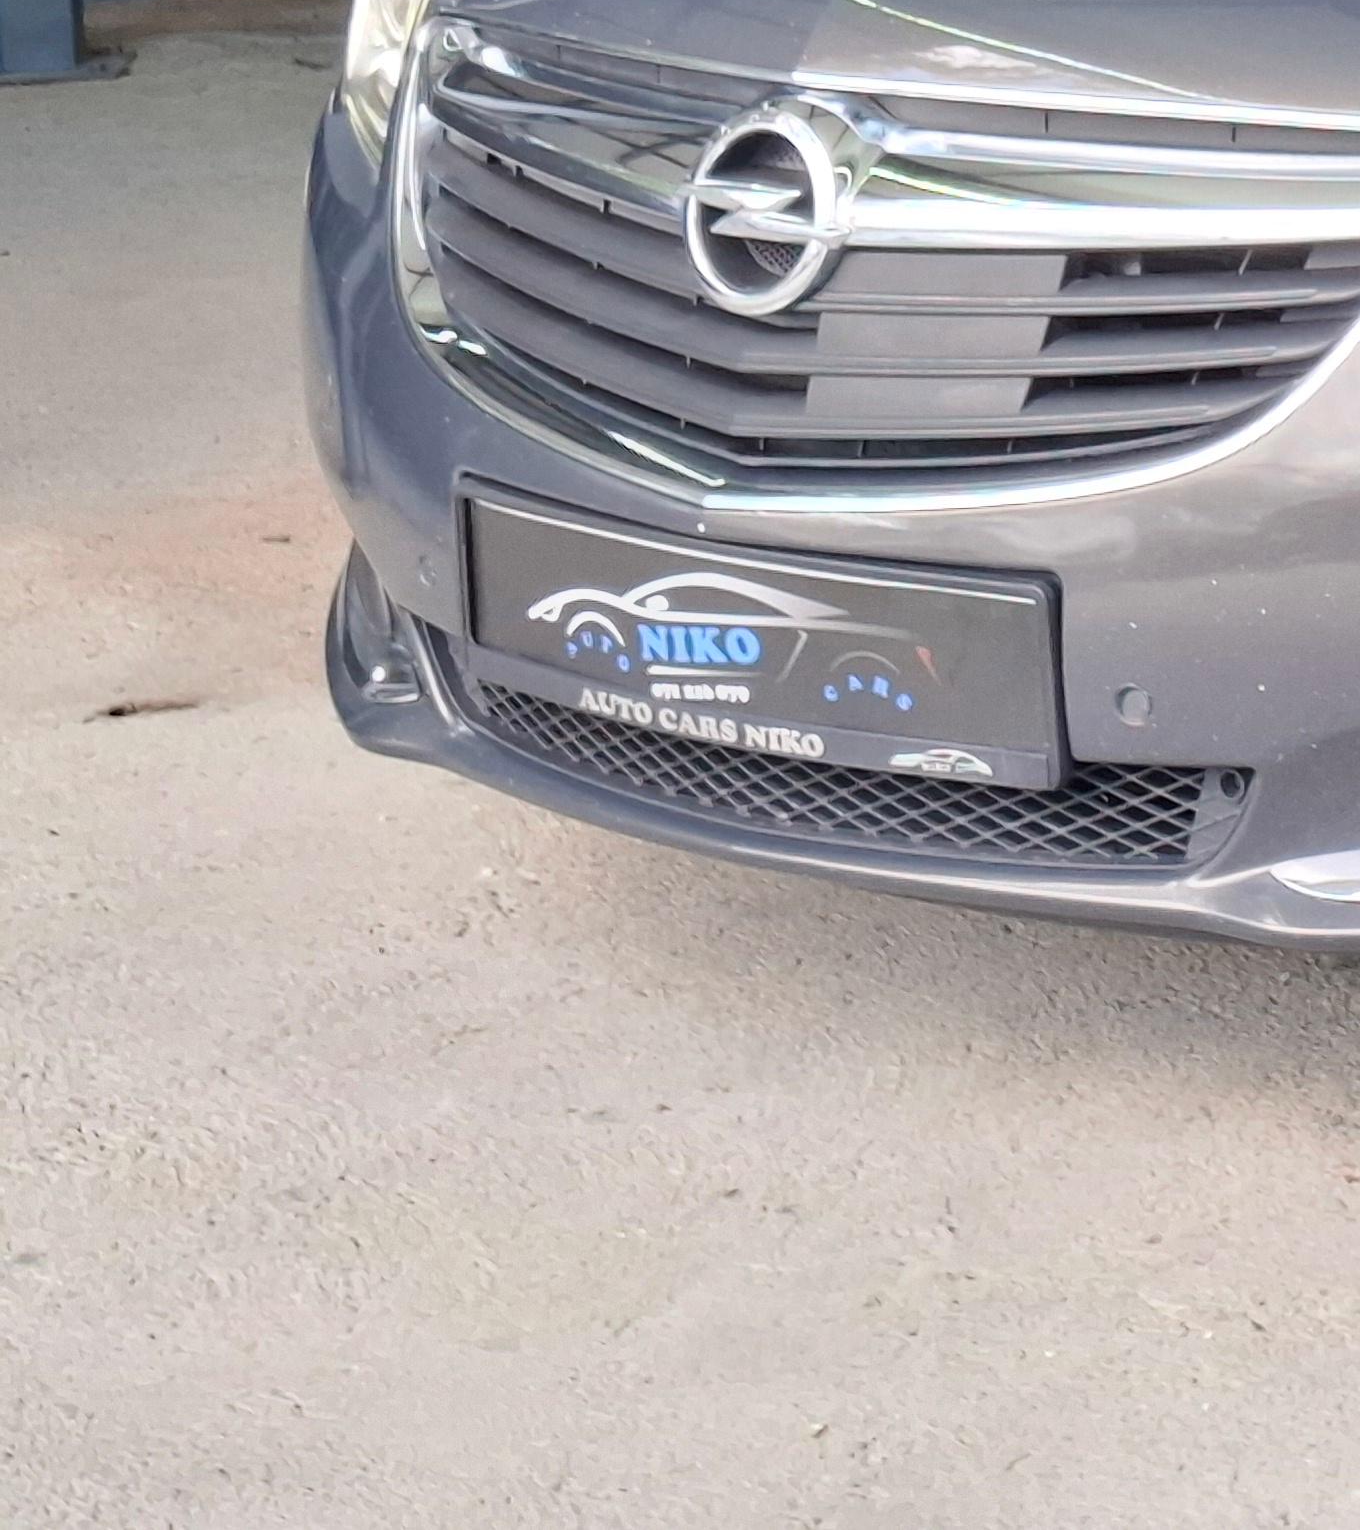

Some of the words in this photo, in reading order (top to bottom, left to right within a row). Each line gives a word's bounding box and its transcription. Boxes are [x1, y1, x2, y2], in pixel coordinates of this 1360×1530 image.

[637, 623, 761, 665] NIKO
[579, 687, 653, 726] AUTO
[658, 707, 738, 744] CARS
[744, 723, 825, 759] NIKO
